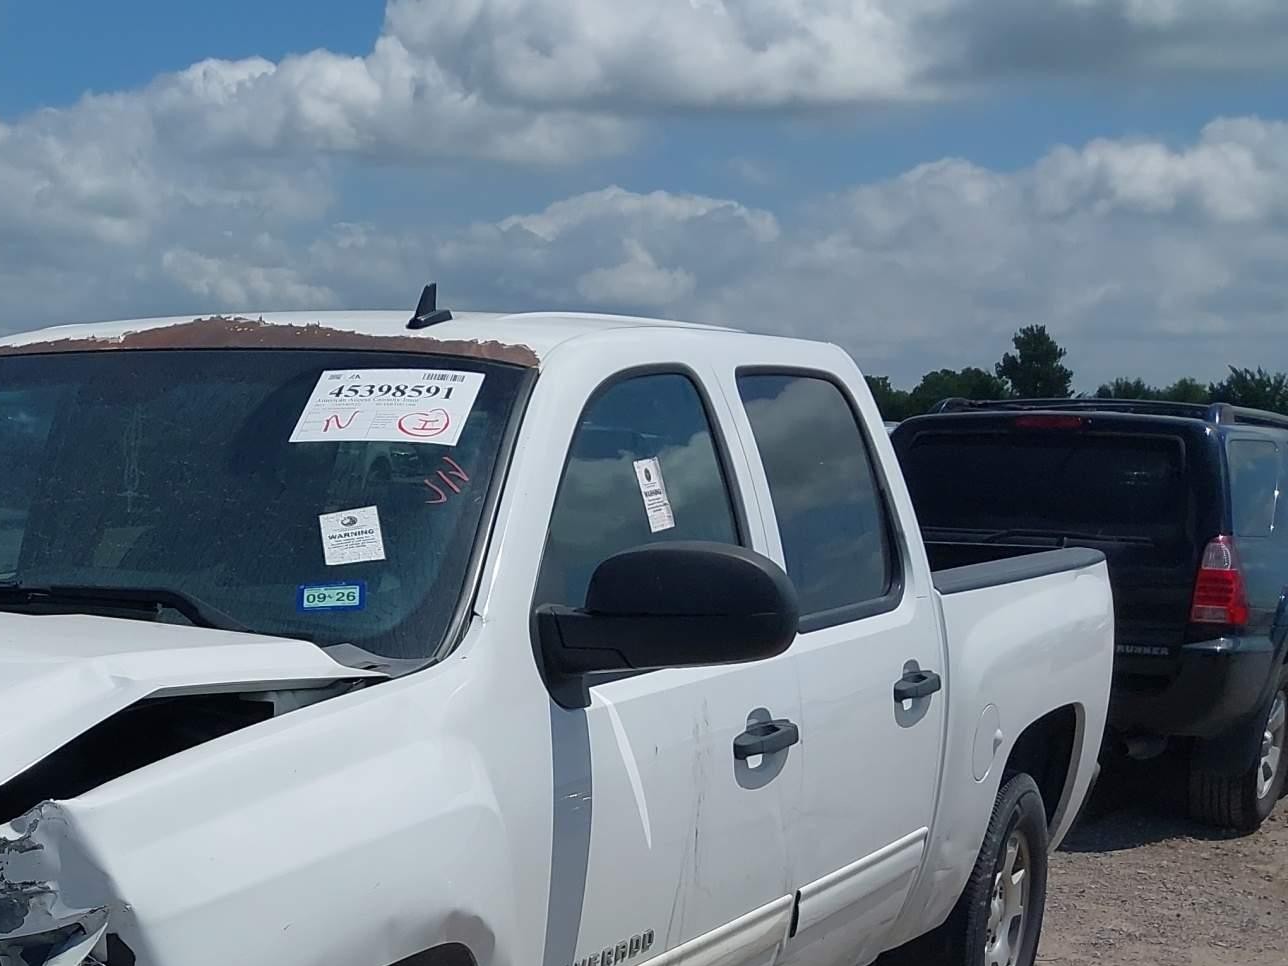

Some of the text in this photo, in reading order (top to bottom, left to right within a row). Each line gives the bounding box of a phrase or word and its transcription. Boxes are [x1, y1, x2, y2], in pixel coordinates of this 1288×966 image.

[328, 384, 454, 400] 45398591
[327, 528, 375, 541] WARNING
[306, 591, 357, 604] 09 26
